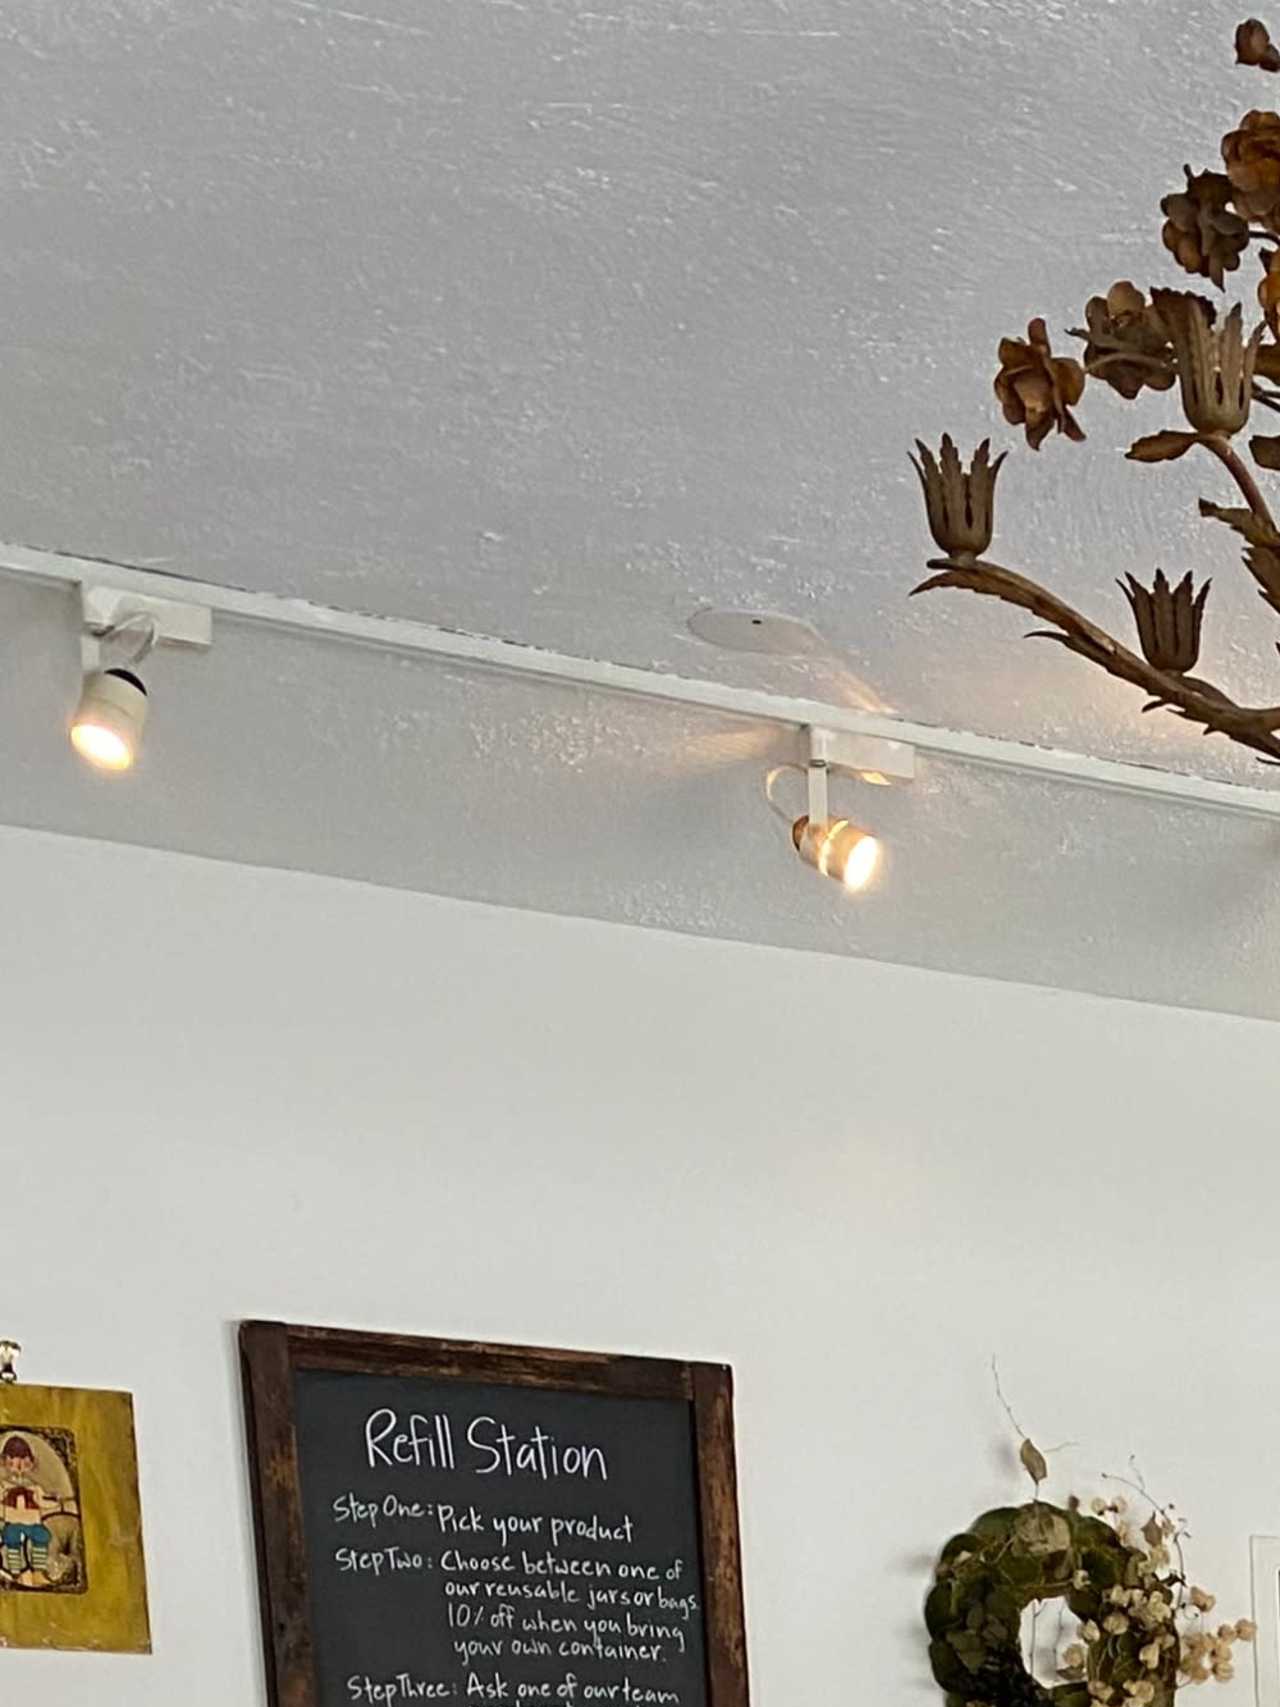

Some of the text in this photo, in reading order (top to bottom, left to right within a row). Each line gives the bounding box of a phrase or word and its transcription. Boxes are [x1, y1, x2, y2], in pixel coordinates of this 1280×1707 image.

[365, 1408, 607, 1480] Refill Station
[332, 1492, 633, 1547] Step One: Pick your product
[336, 1546, 683, 1580] Step Two: Choose between one of
[445, 1581, 480, 1597] our
[485, 1580, 579, 1603] reusable
[588, 1585, 631, 1610] jars
[634, 1593, 653, 1606] or
[449, 1602, 685, 1652] 10% off when you bring
[454, 1640, 502, 1666] your
[511, 1639, 551, 1656] own
[467, 1672, 508, 1698] Ask
[517, 1683, 550, 1697] one
[556, 1672, 577, 1698] of
[584, 1685, 619, 1699] our
[622, 1676, 680, 1704] team
